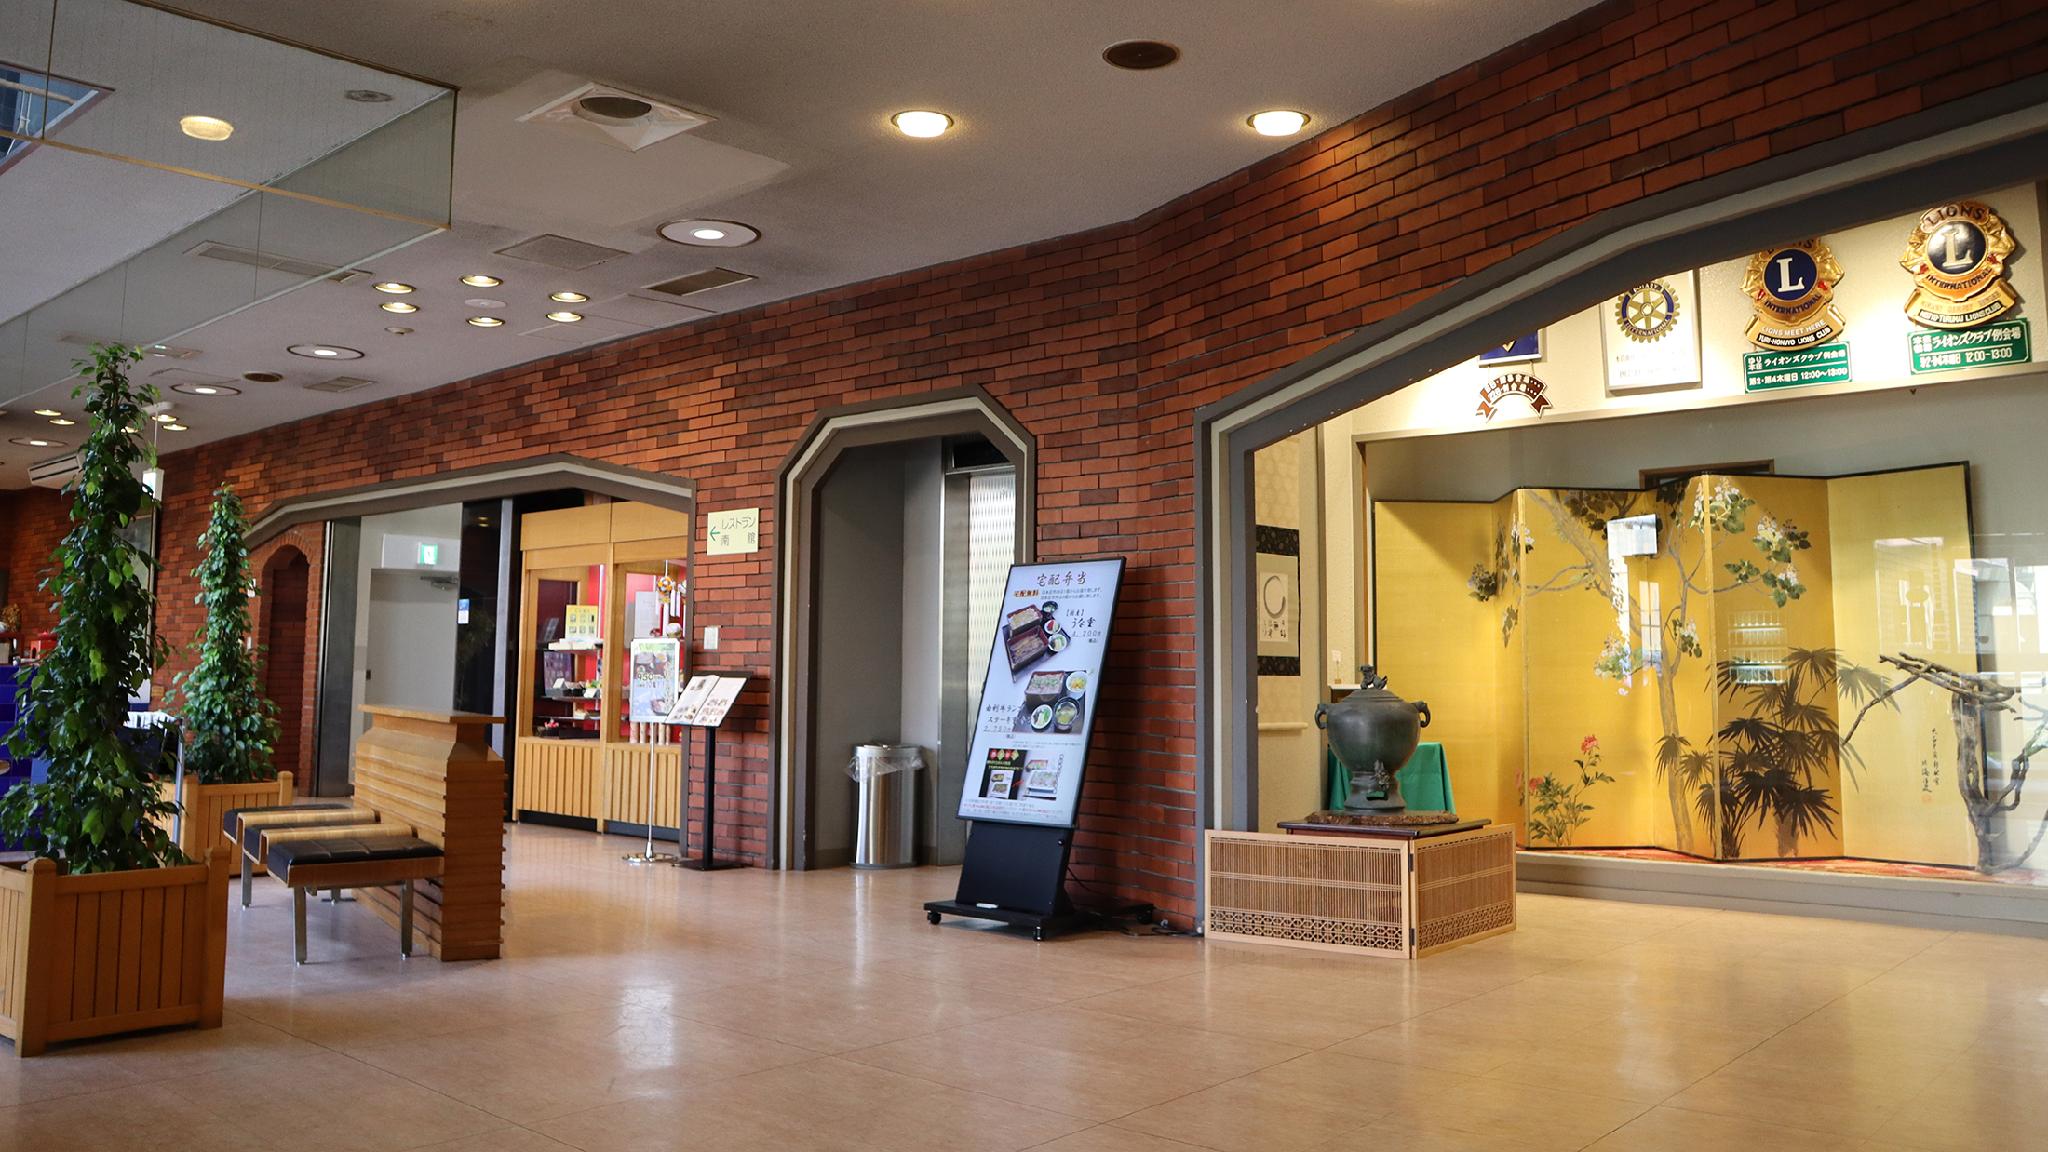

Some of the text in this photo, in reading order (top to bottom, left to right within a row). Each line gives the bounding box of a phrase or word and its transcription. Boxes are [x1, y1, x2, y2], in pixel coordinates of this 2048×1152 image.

[1926, 205, 1985, 226] LIONS
[1941, 232, 1974, 267] L
[1776, 257, 1805, 293] L
[1925, 268, 1993, 290] INTERNATIONAL
[1764, 293, 1822, 314] INTERNATIONAL
[1761, 320, 1827, 336] LIONS MEET HERE
[1797, 334, 1815, 345] LIONS
[1816, 326, 1832, 339] CLUB
[721, 516, 756, 530] レストラン
[1036, 571, 1087, 587] 宅配弁当
